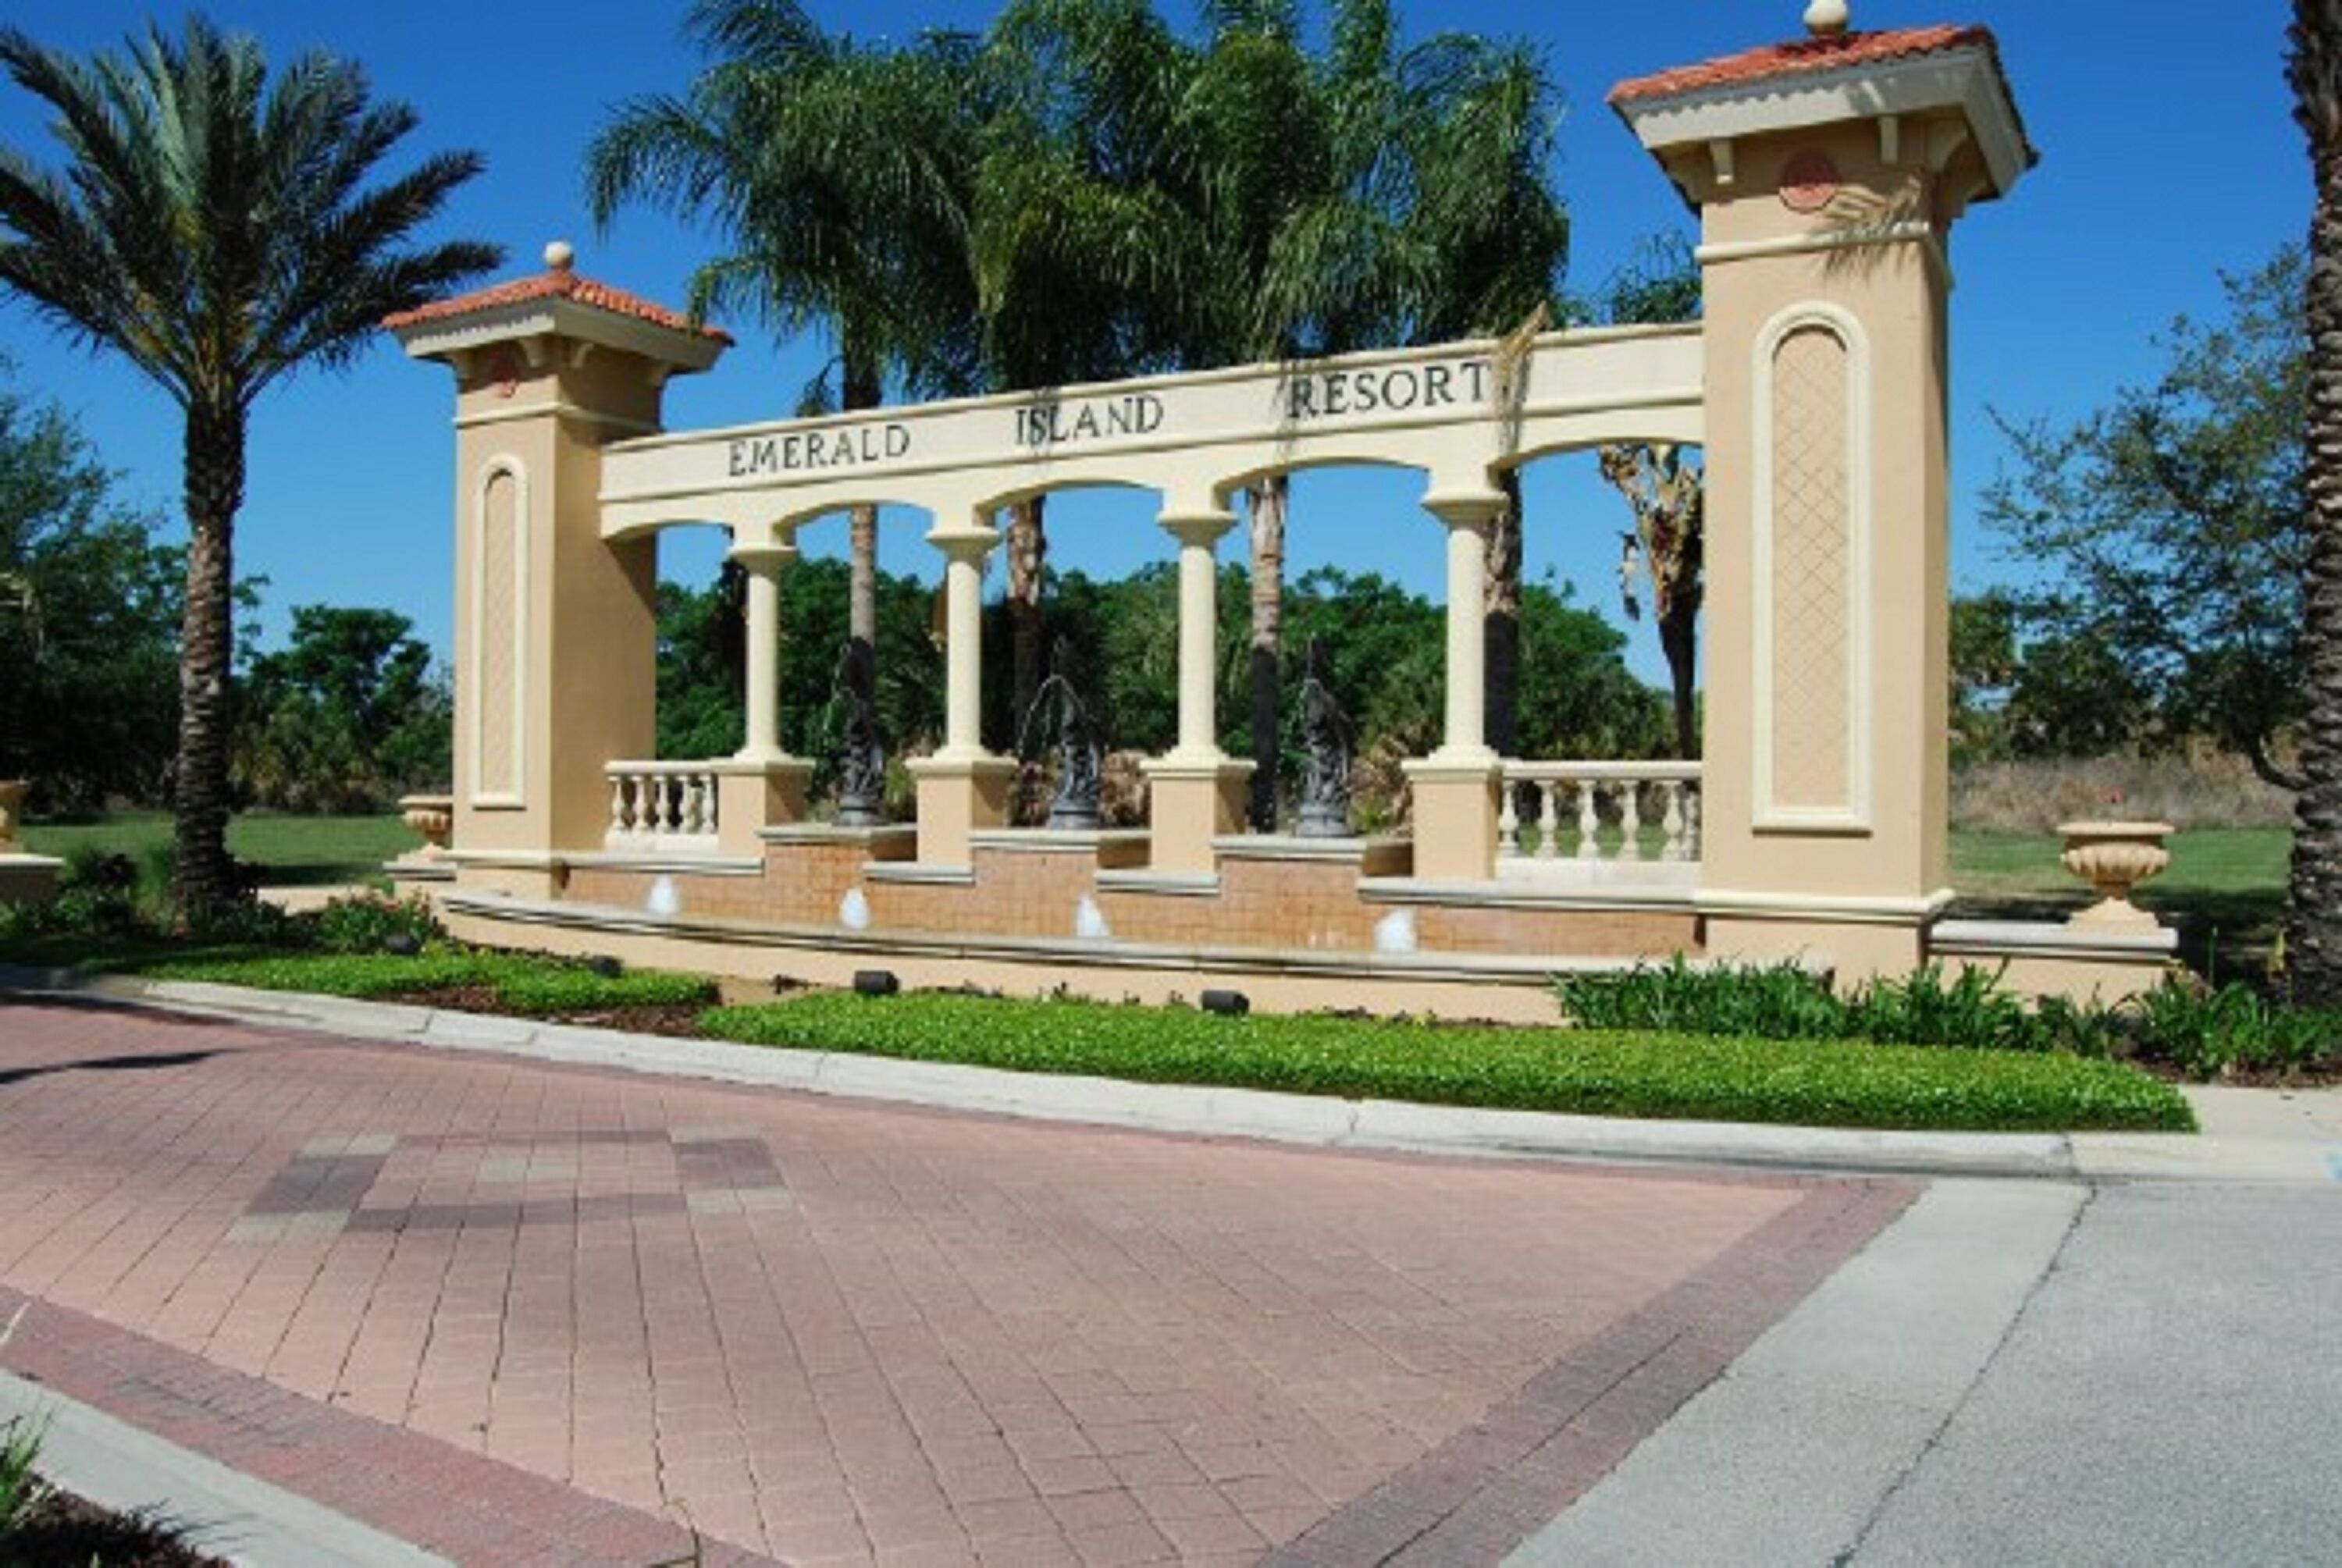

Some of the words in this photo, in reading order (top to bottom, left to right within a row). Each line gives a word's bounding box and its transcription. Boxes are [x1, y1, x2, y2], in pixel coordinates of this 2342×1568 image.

[729, 424, 911, 476] EMERALD
[1016, 394, 1164, 446] ISLAND
[1288, 360, 1492, 418] RESORT
